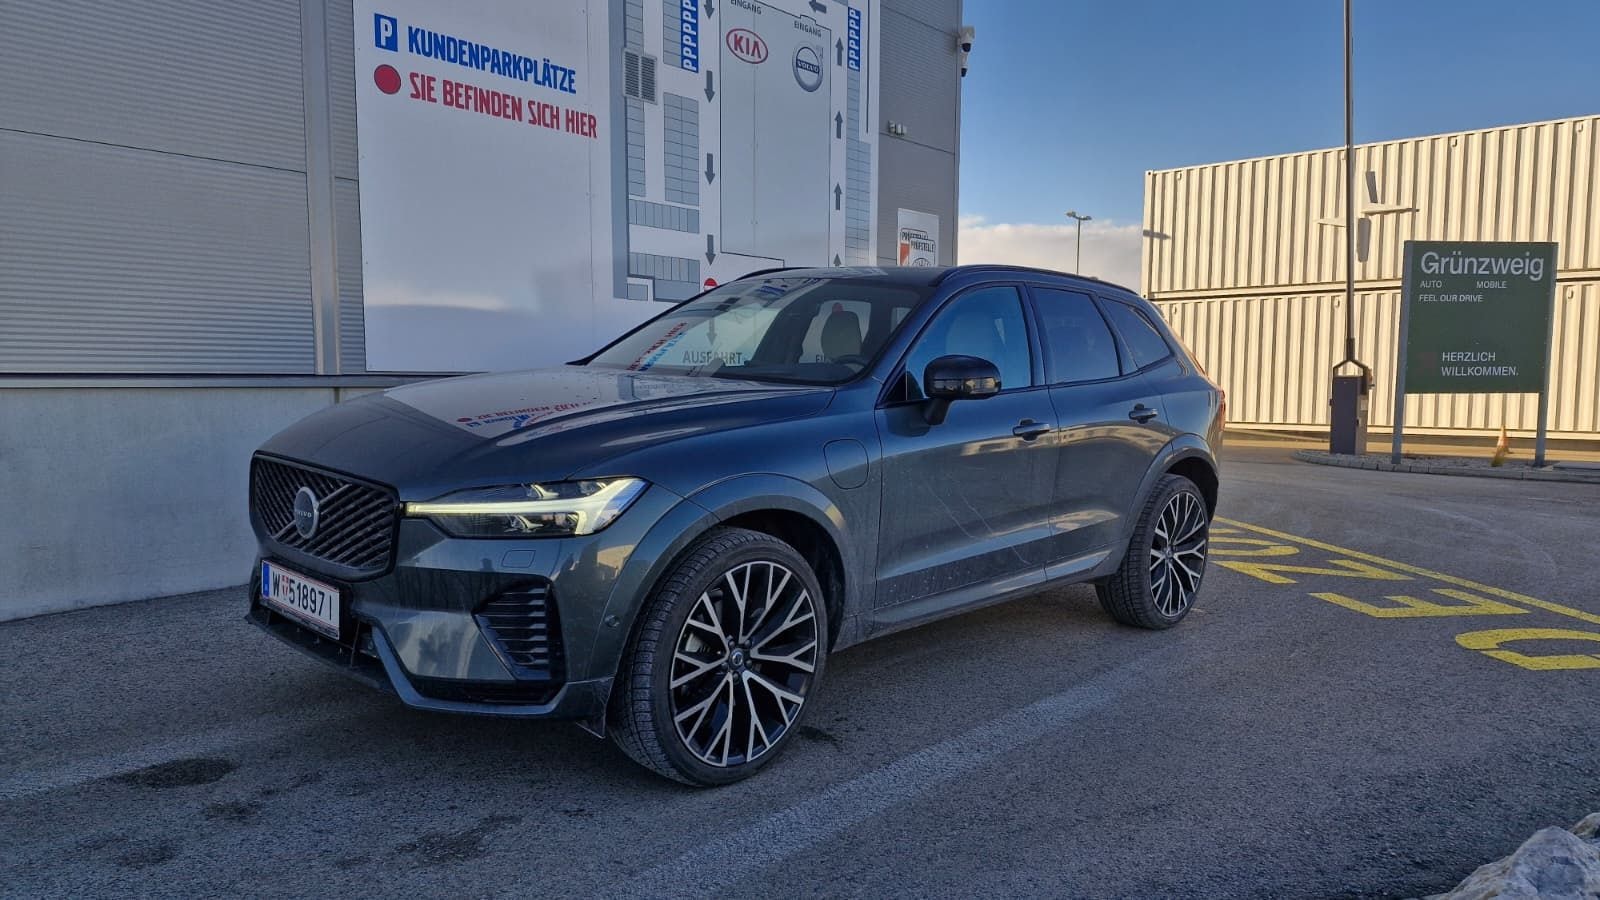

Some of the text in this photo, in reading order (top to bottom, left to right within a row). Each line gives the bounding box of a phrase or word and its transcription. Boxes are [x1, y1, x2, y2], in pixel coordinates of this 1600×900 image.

[794, 20, 821, 37] EINGANG
[734, 33, 762, 59] KIA
[379, 18, 577, 94] P KUNDENPARKPLÄTZE
[797, 60, 819, 72] VOLVO
[410, 72, 598, 139] SIE BEFINDEN SICH HIER
[1420, 250, 1544, 281] Grünzweig
[1420, 280, 1507, 289] AUTO MOBILE
[1419, 294, 1483, 302] FEEL OUR DRIVE
[1442, 352, 1496, 361] HERZLICH
[1441, 366, 1519, 376] WILLKOMMEN.
[272, 571, 280, 597] W
[288, 577, 326, 616] 51897
